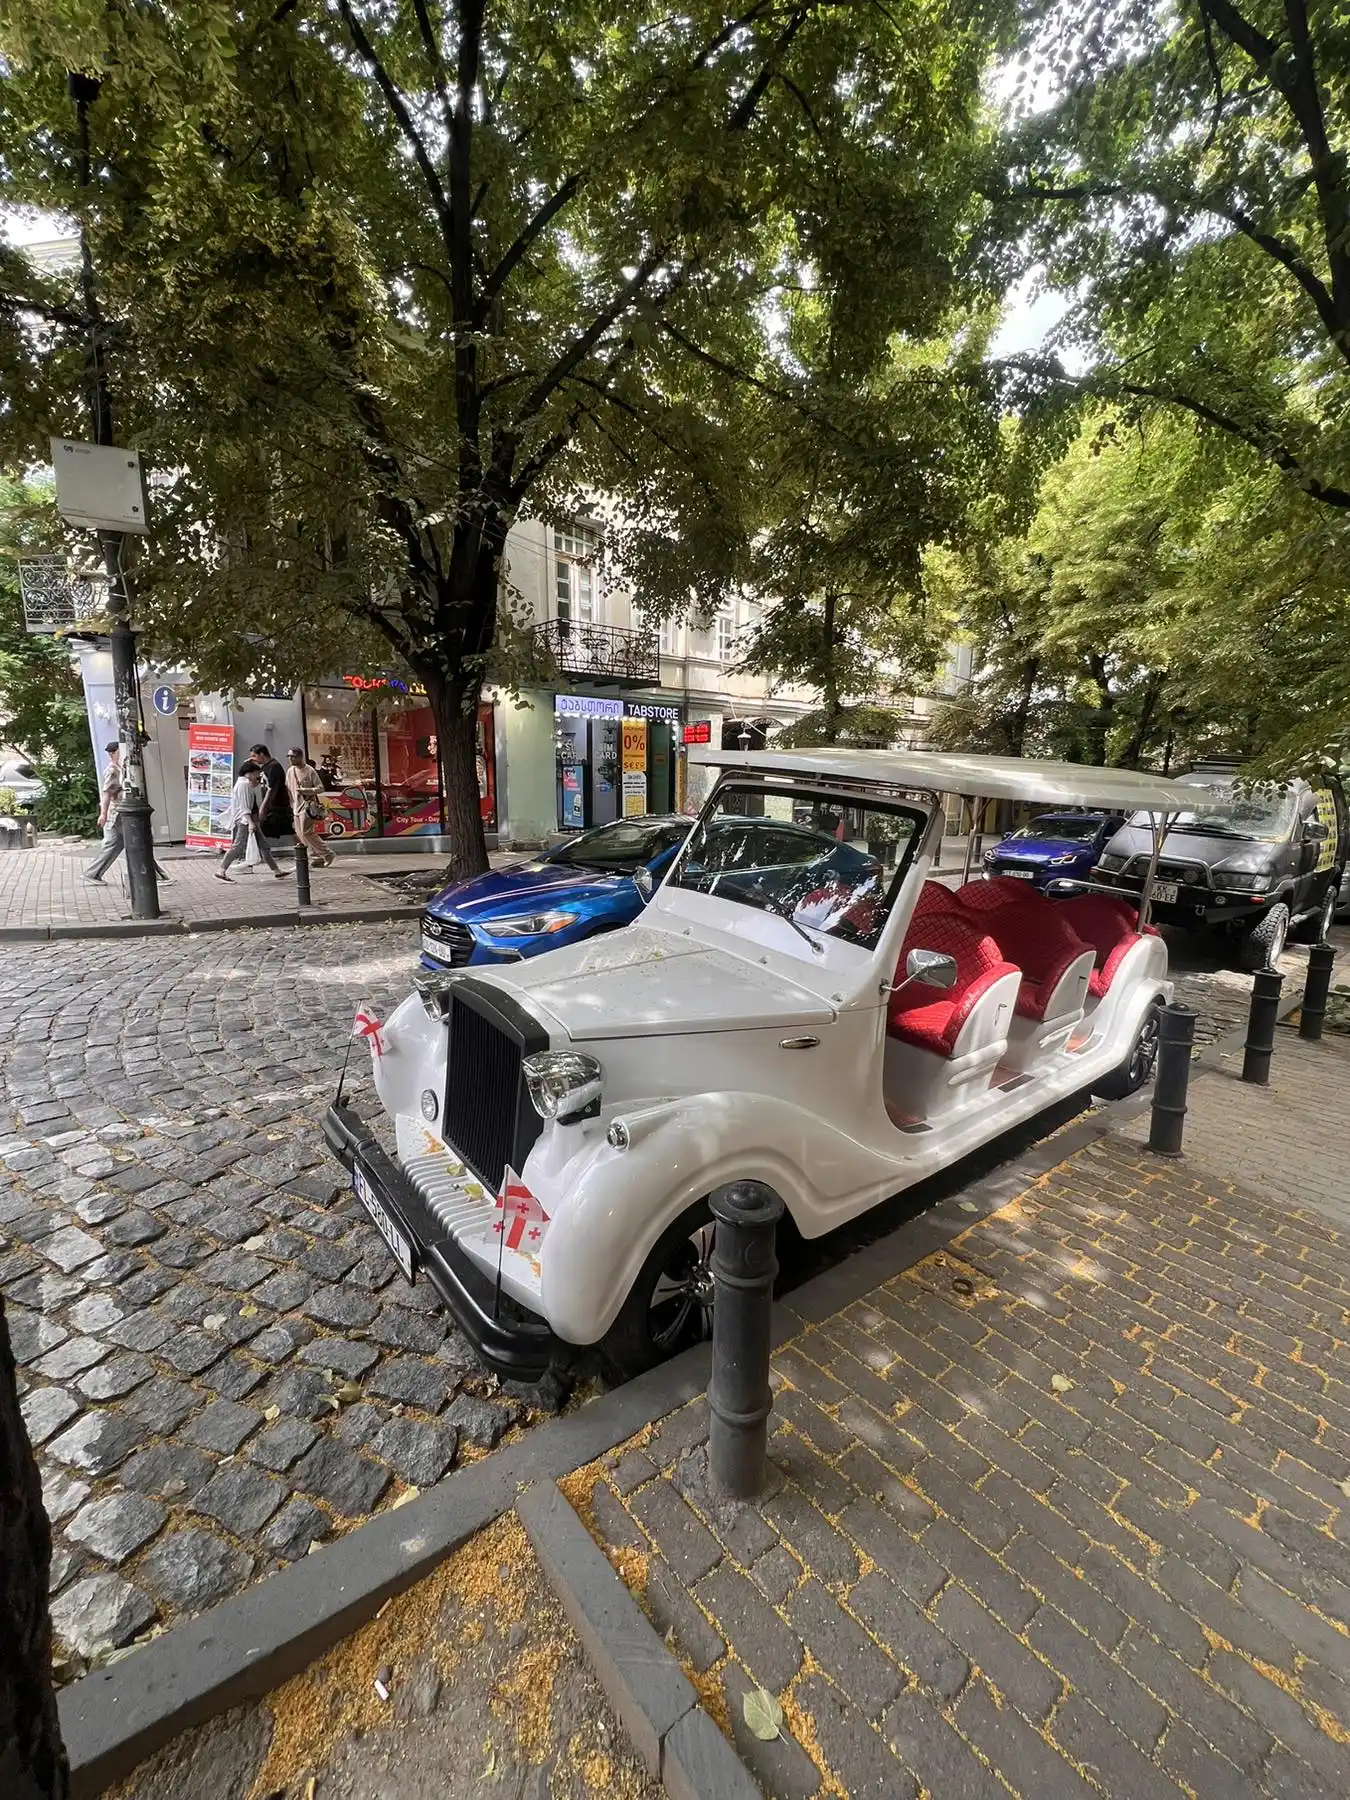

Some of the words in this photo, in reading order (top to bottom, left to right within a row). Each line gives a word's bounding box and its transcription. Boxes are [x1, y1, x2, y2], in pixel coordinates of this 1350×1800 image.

[628, 704, 679, 719] TABSTORE
[624, 735, 645, 751] 0%
[396, 816, 409, 824] City
